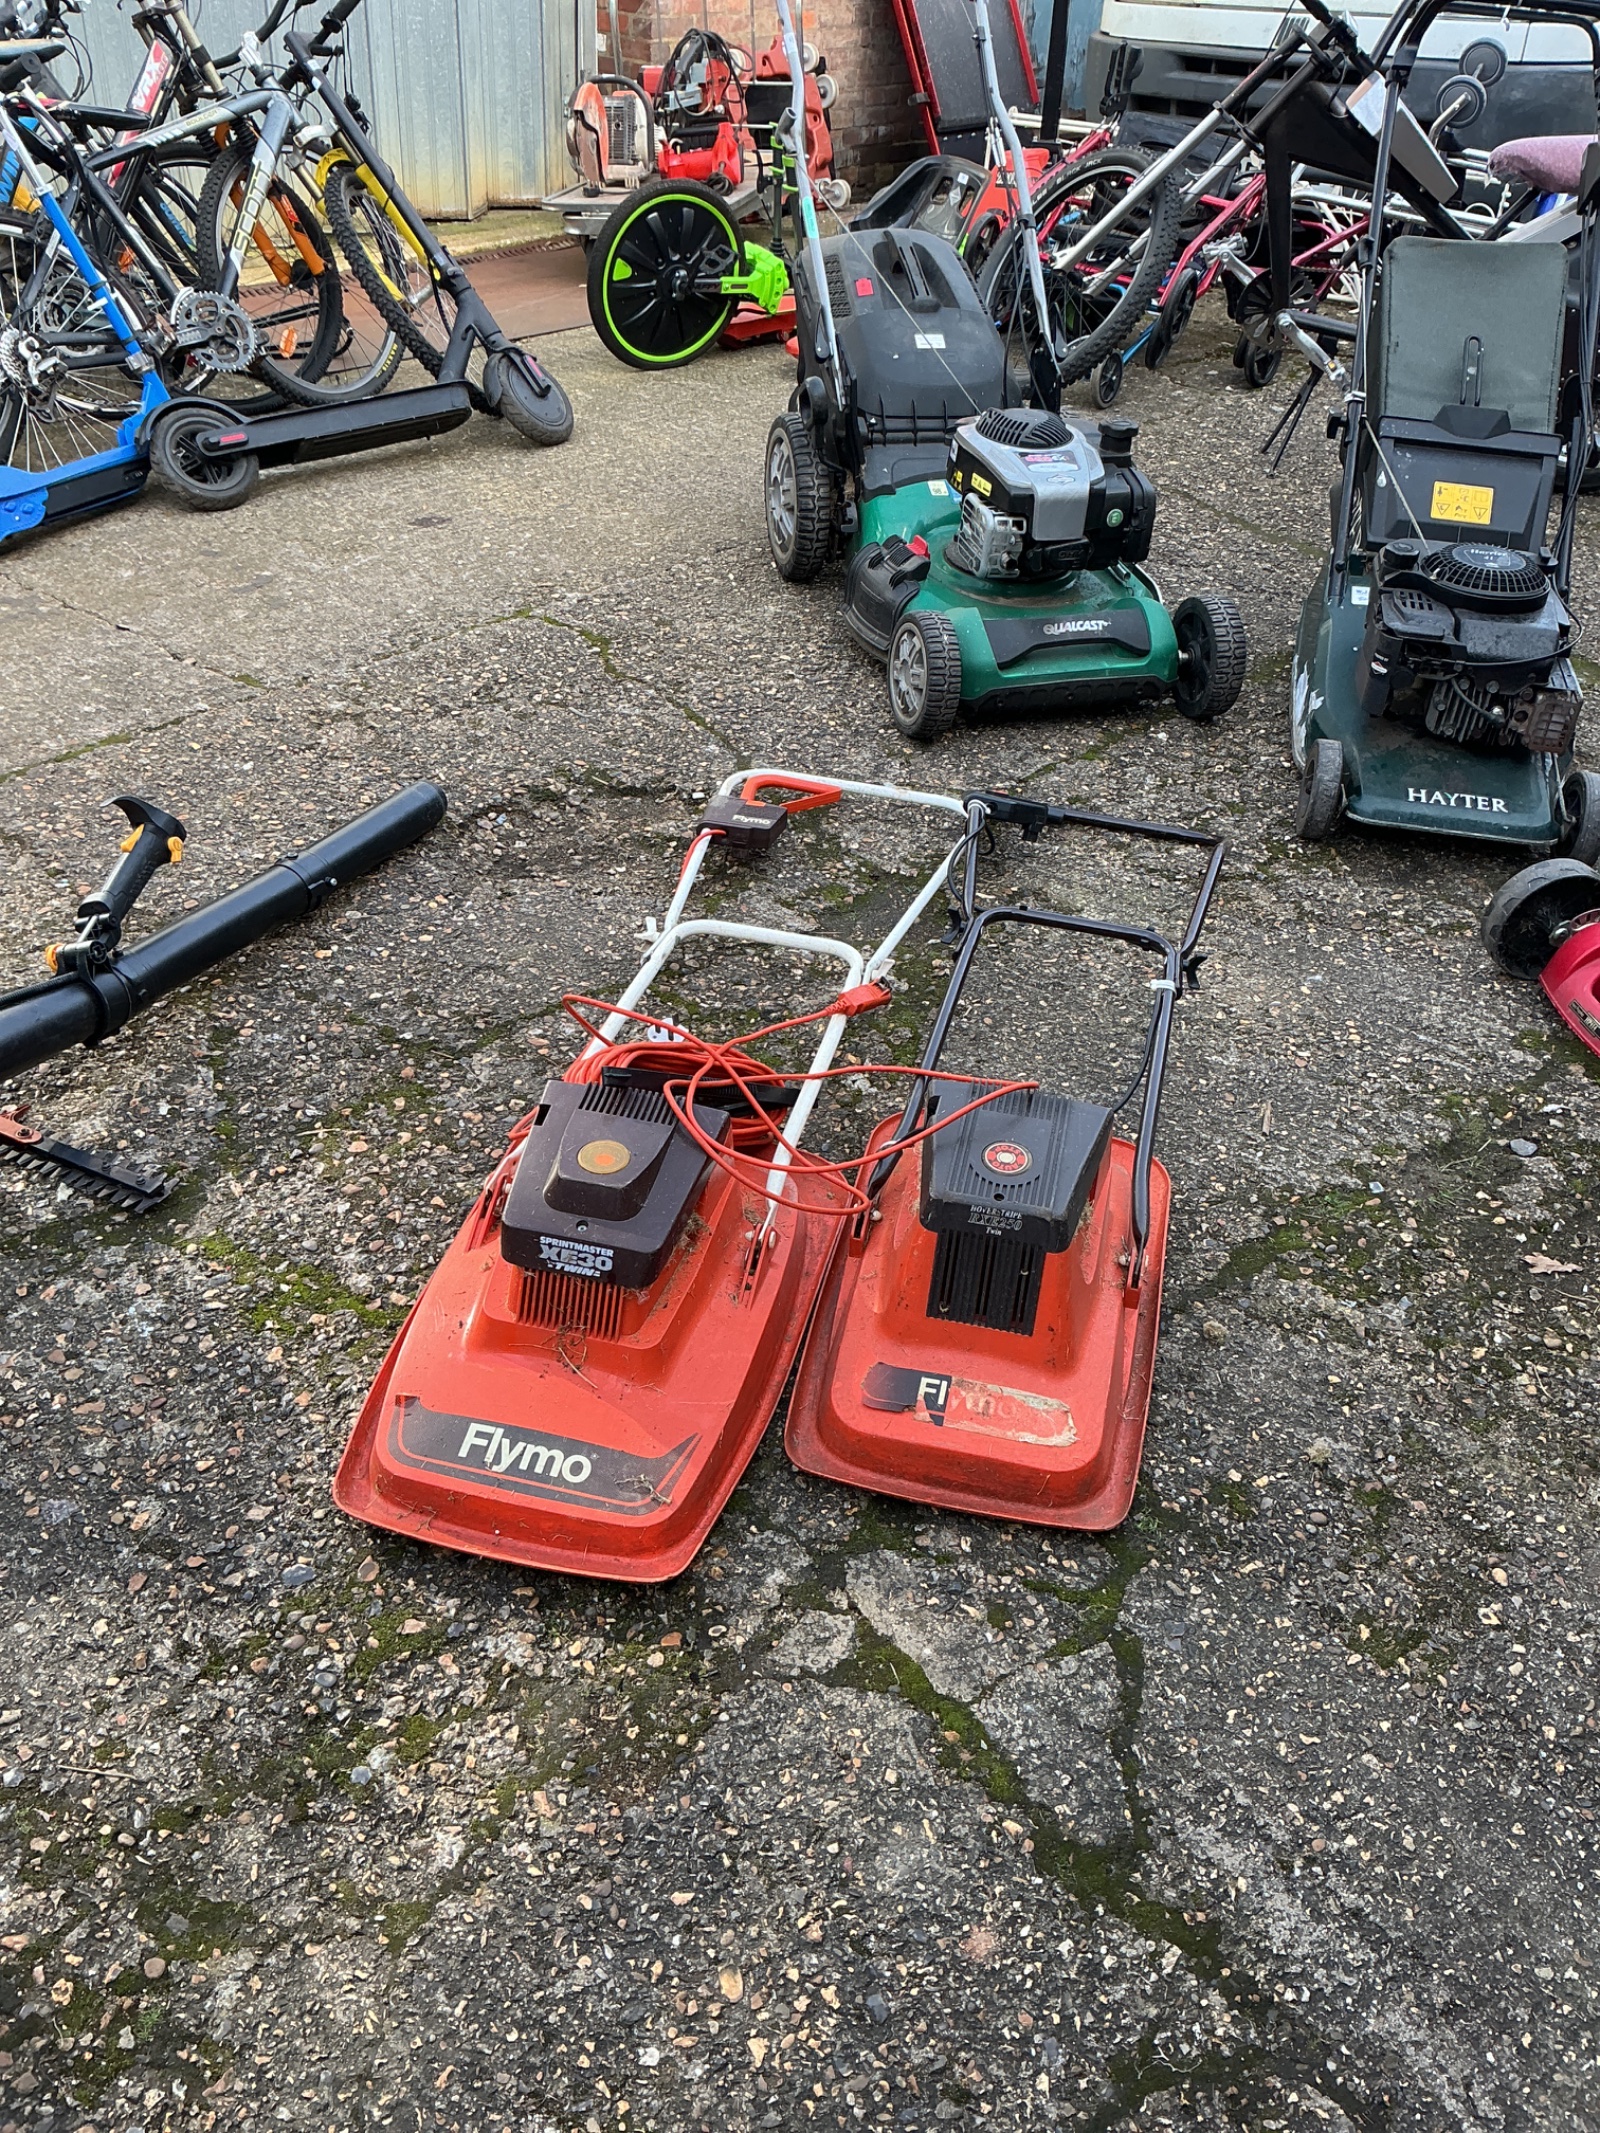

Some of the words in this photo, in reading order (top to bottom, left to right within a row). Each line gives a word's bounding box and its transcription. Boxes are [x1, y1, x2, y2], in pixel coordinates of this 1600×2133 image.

[233, 160, 271, 257] SCOTT
[1043, 620, 1104, 636] QUALCAST
[1407, 787, 1509, 813] HAYTER
[732, 814, 771, 825] Flymo
[967, 1212, 1023, 1231] RXE250
[540, 1235, 614, 1257] SPRINTMASTER
[539, 1244, 613, 1272] XE30
[554, 1261, 595, 1277] TWIN
[457, 1422, 593, 1485] Flymo
